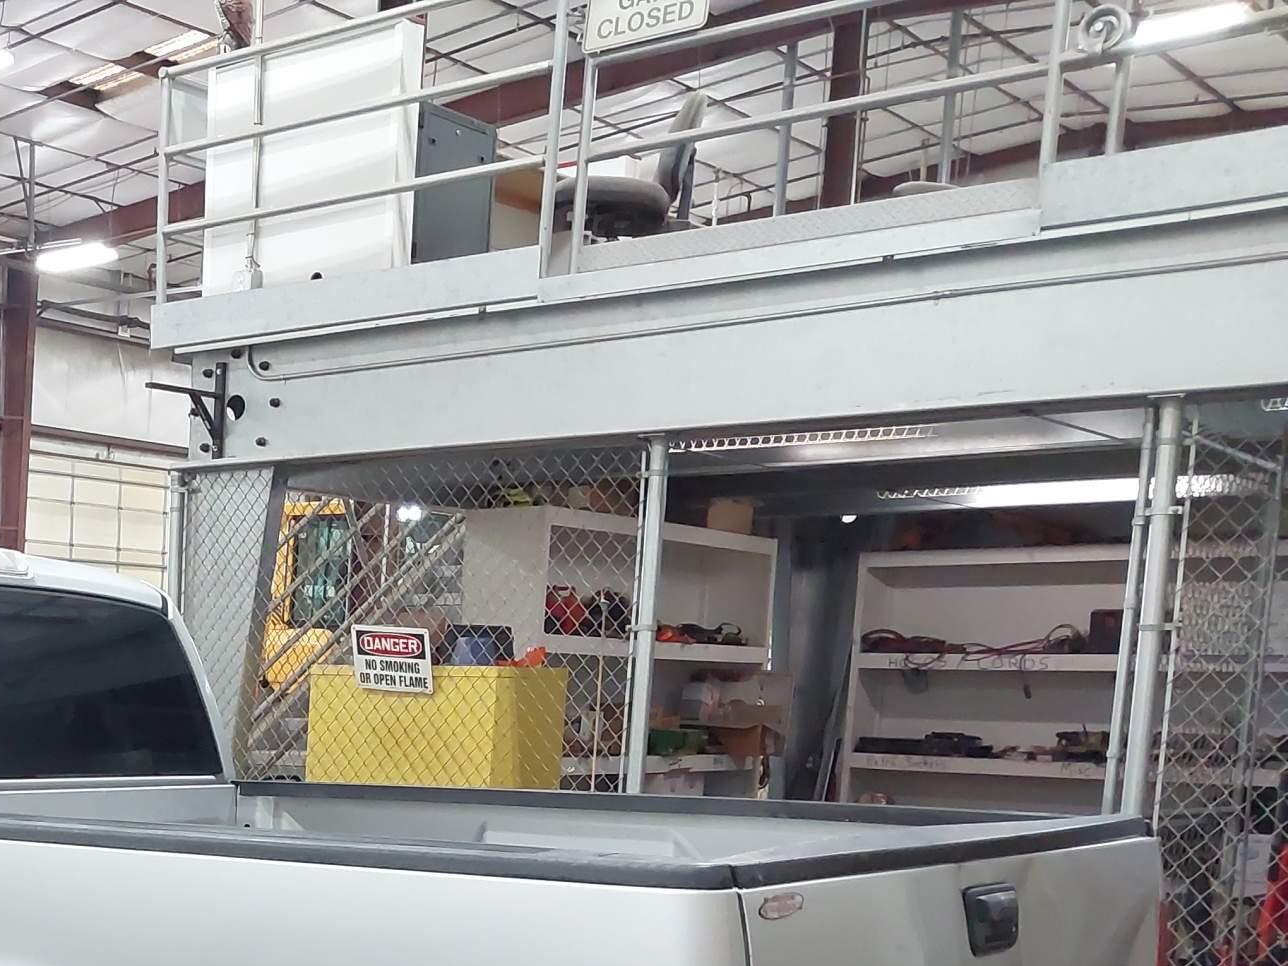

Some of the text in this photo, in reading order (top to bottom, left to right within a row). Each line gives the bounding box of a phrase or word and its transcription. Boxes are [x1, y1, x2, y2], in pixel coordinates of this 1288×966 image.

[597, 1, 694, 39] CLOSED
[364, 637, 418, 652] DANGER
[365, 659, 420, 673] NO SMOKING
[360, 672, 428, 688] OR OPEN FLAME
